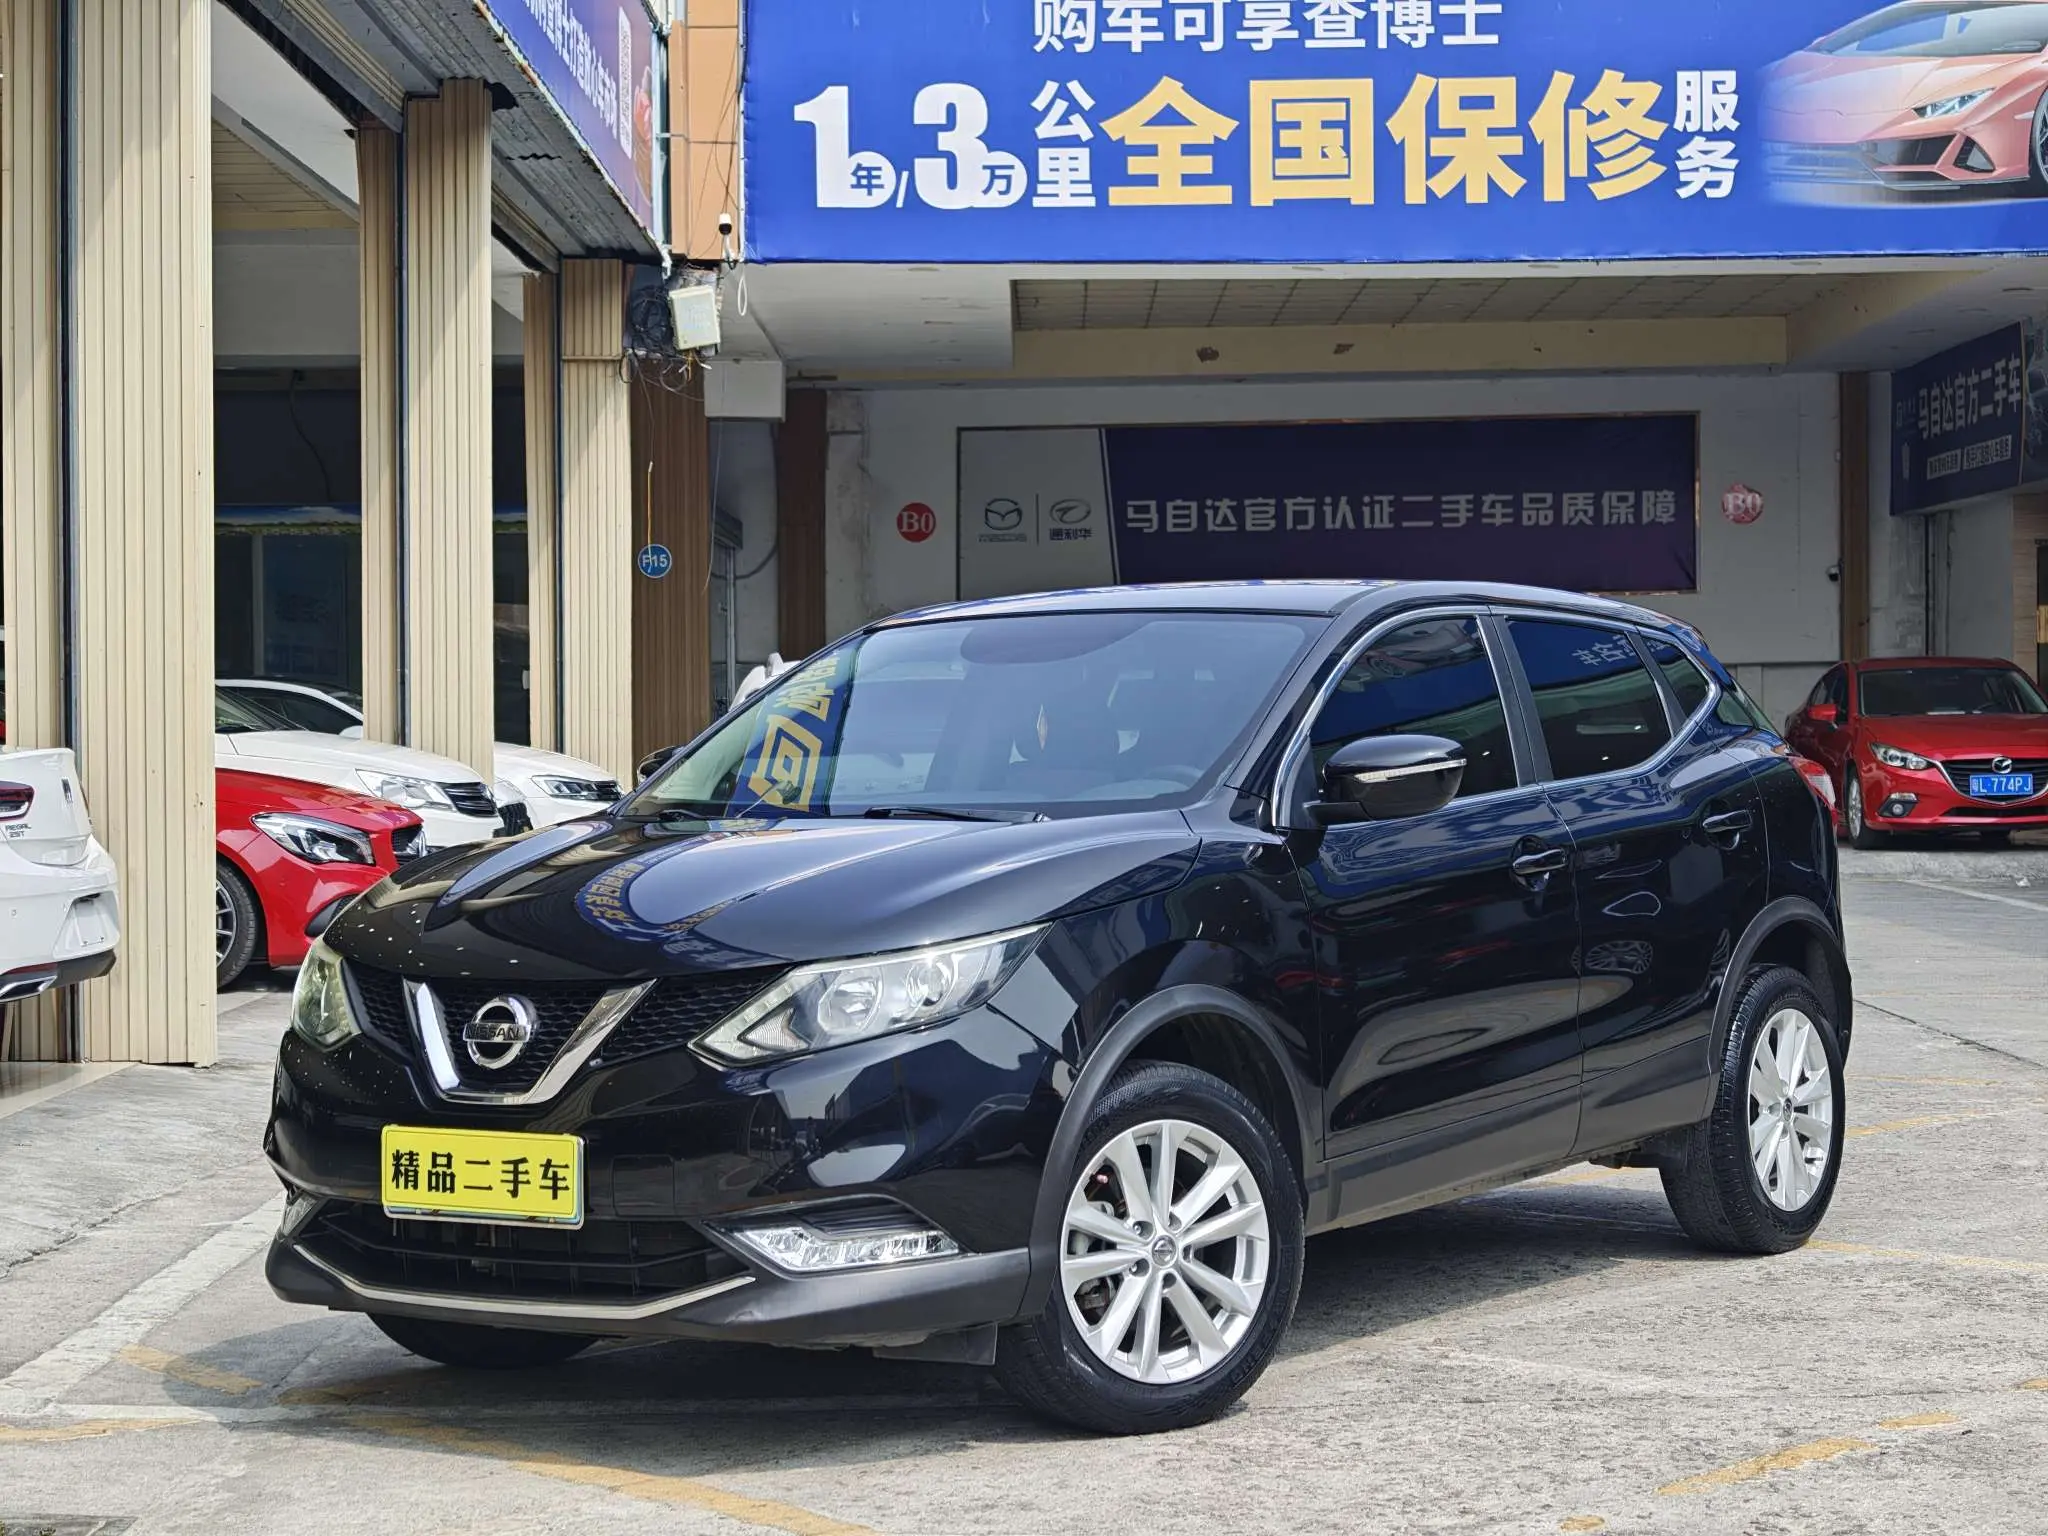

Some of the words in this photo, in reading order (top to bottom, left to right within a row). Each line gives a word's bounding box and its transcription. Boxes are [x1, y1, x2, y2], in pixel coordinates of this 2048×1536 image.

[1033, 0, 1502, 53] 购车可享查博士
[1031, 80, 1096, 208] 公里
[1103, 71, 1667, 205] 全国保修
[1673, 70, 1740, 199] 服务
[1917, 353, 2022, 441] 马自达官方二手车
[1126, 489, 1676, 533] 马自达官方认证二手车品质保障
[465, 1023, 520, 1041] NISSAN
[391, 1149, 570, 1201] 精品二手车
